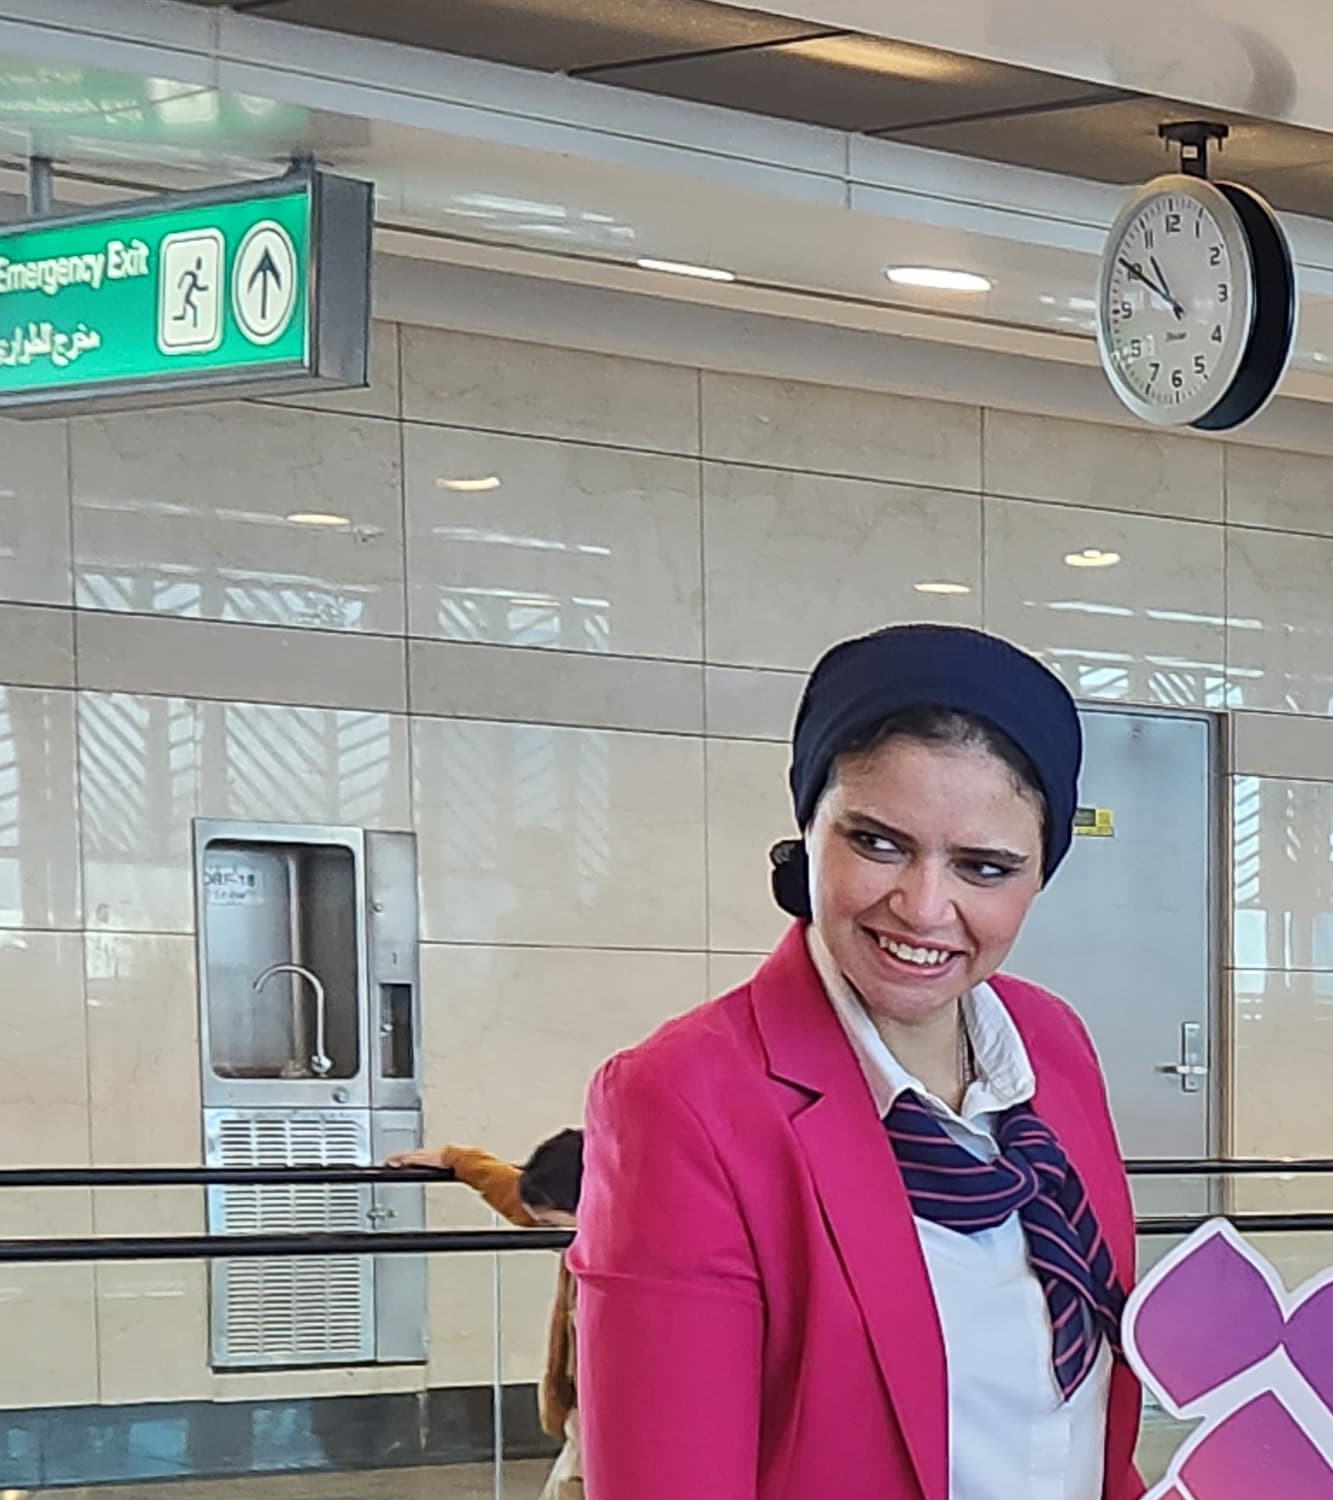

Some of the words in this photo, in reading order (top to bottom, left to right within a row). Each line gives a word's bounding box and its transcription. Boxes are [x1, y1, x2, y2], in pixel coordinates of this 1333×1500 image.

[1166, 214, 1181, 233] 12
[1195, 219, 1200, 239] 1
[1145, 230, 1155, 249] 11
[1210, 246, 1221, 266] 2
[0, 252, 105, 295] Emergency
[107, 239, 150, 279] Exit
[1217, 283, 1229, 303] 3
[1120, 301, 1132, 319] 9
[1211, 324, 1223, 343] 4
[52, 322, 101, 367] مخرج
[1149, 362, 1161, 382] 7
[1194, 355, 1206, 375] 5
[1171, 369, 1183, 388] 6
